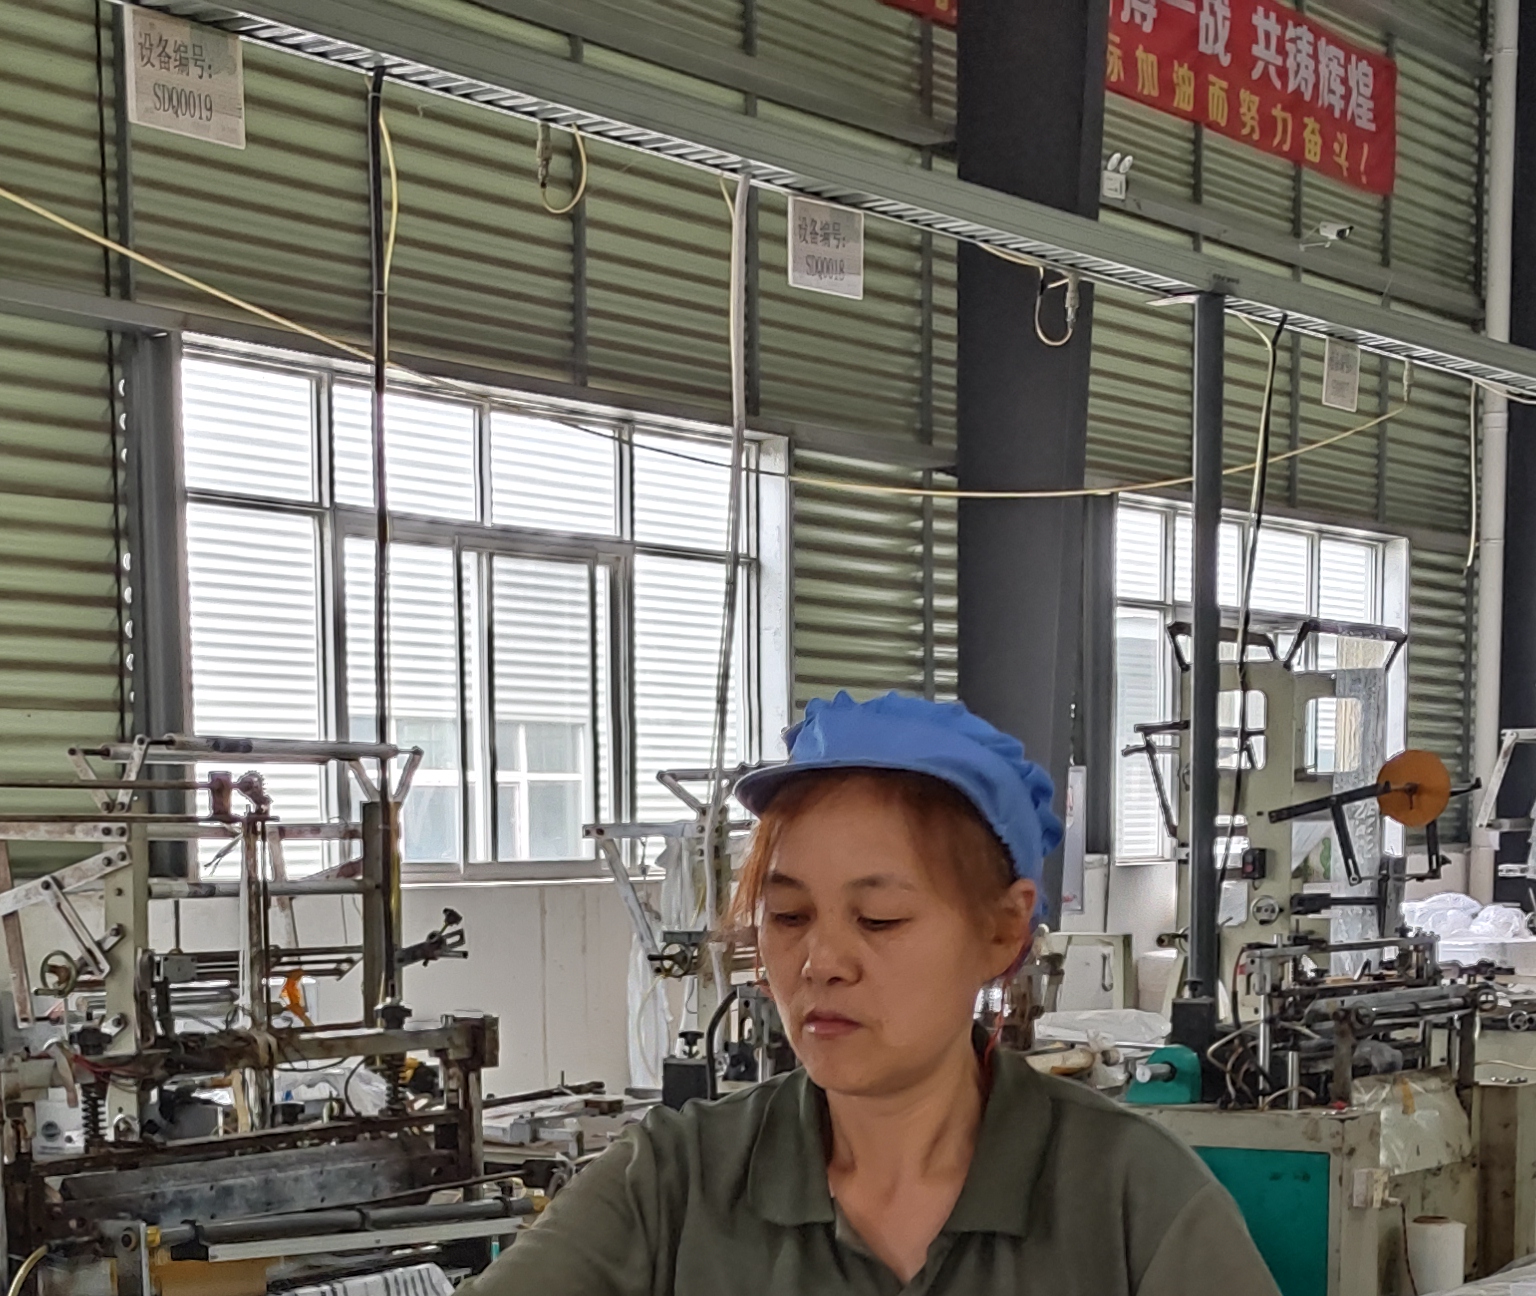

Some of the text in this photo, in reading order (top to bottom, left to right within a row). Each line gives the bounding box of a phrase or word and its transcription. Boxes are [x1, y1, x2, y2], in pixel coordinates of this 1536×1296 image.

[153, 82, 213, 121] SDQ0019
[1251, 6, 1376, 131] 共铸辉煌
